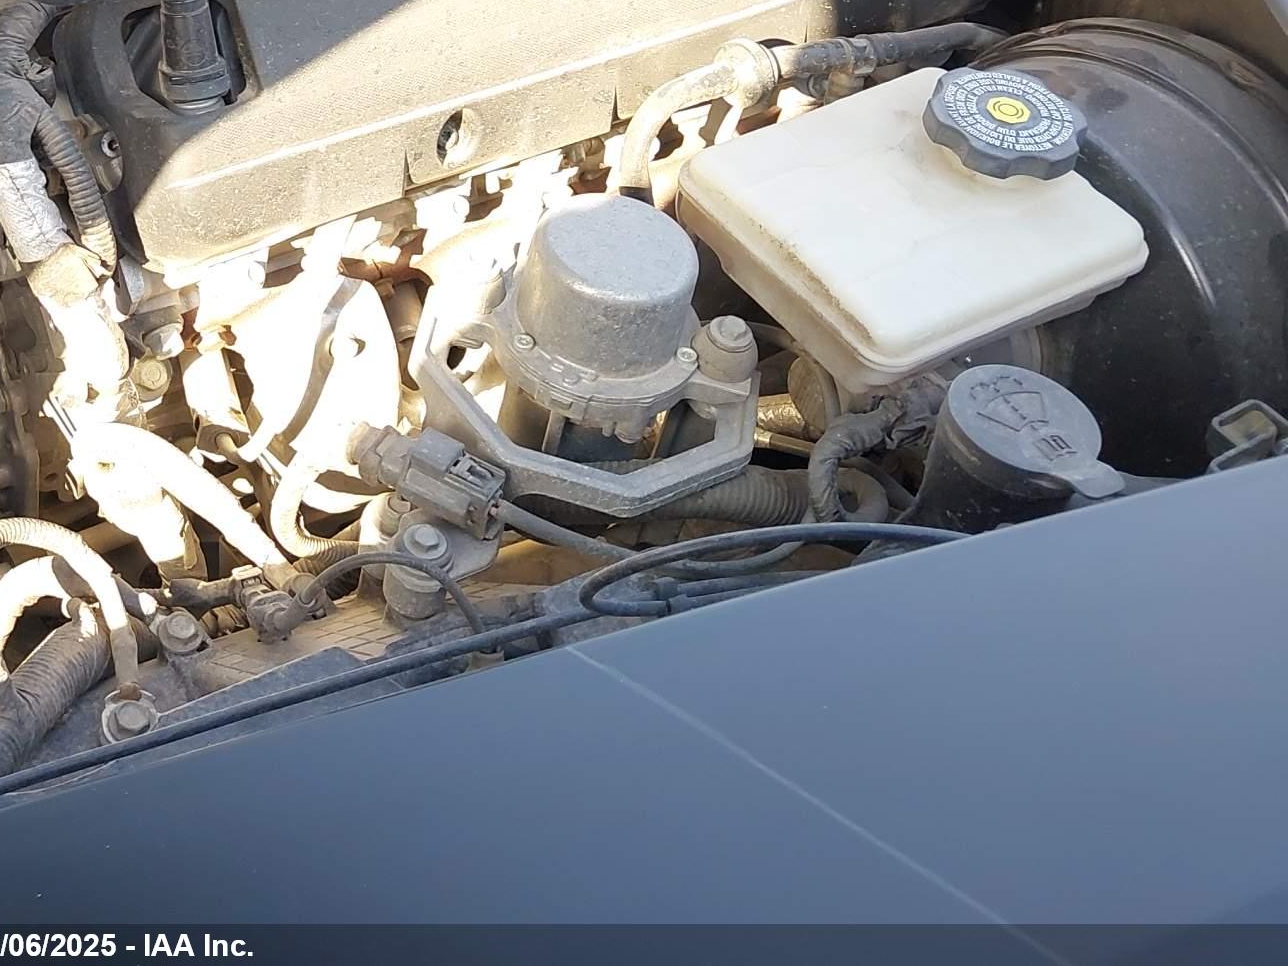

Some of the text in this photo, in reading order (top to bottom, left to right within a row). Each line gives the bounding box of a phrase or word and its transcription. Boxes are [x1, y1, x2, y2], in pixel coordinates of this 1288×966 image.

[996, 84, 1023, 95] CLEAN
[1026, 81, 1050, 95] FROM
[1048, 109, 1062, 119] CAP
[1003, 134, 1016, 143] DU
[1001, 141, 1013, 149] LE
